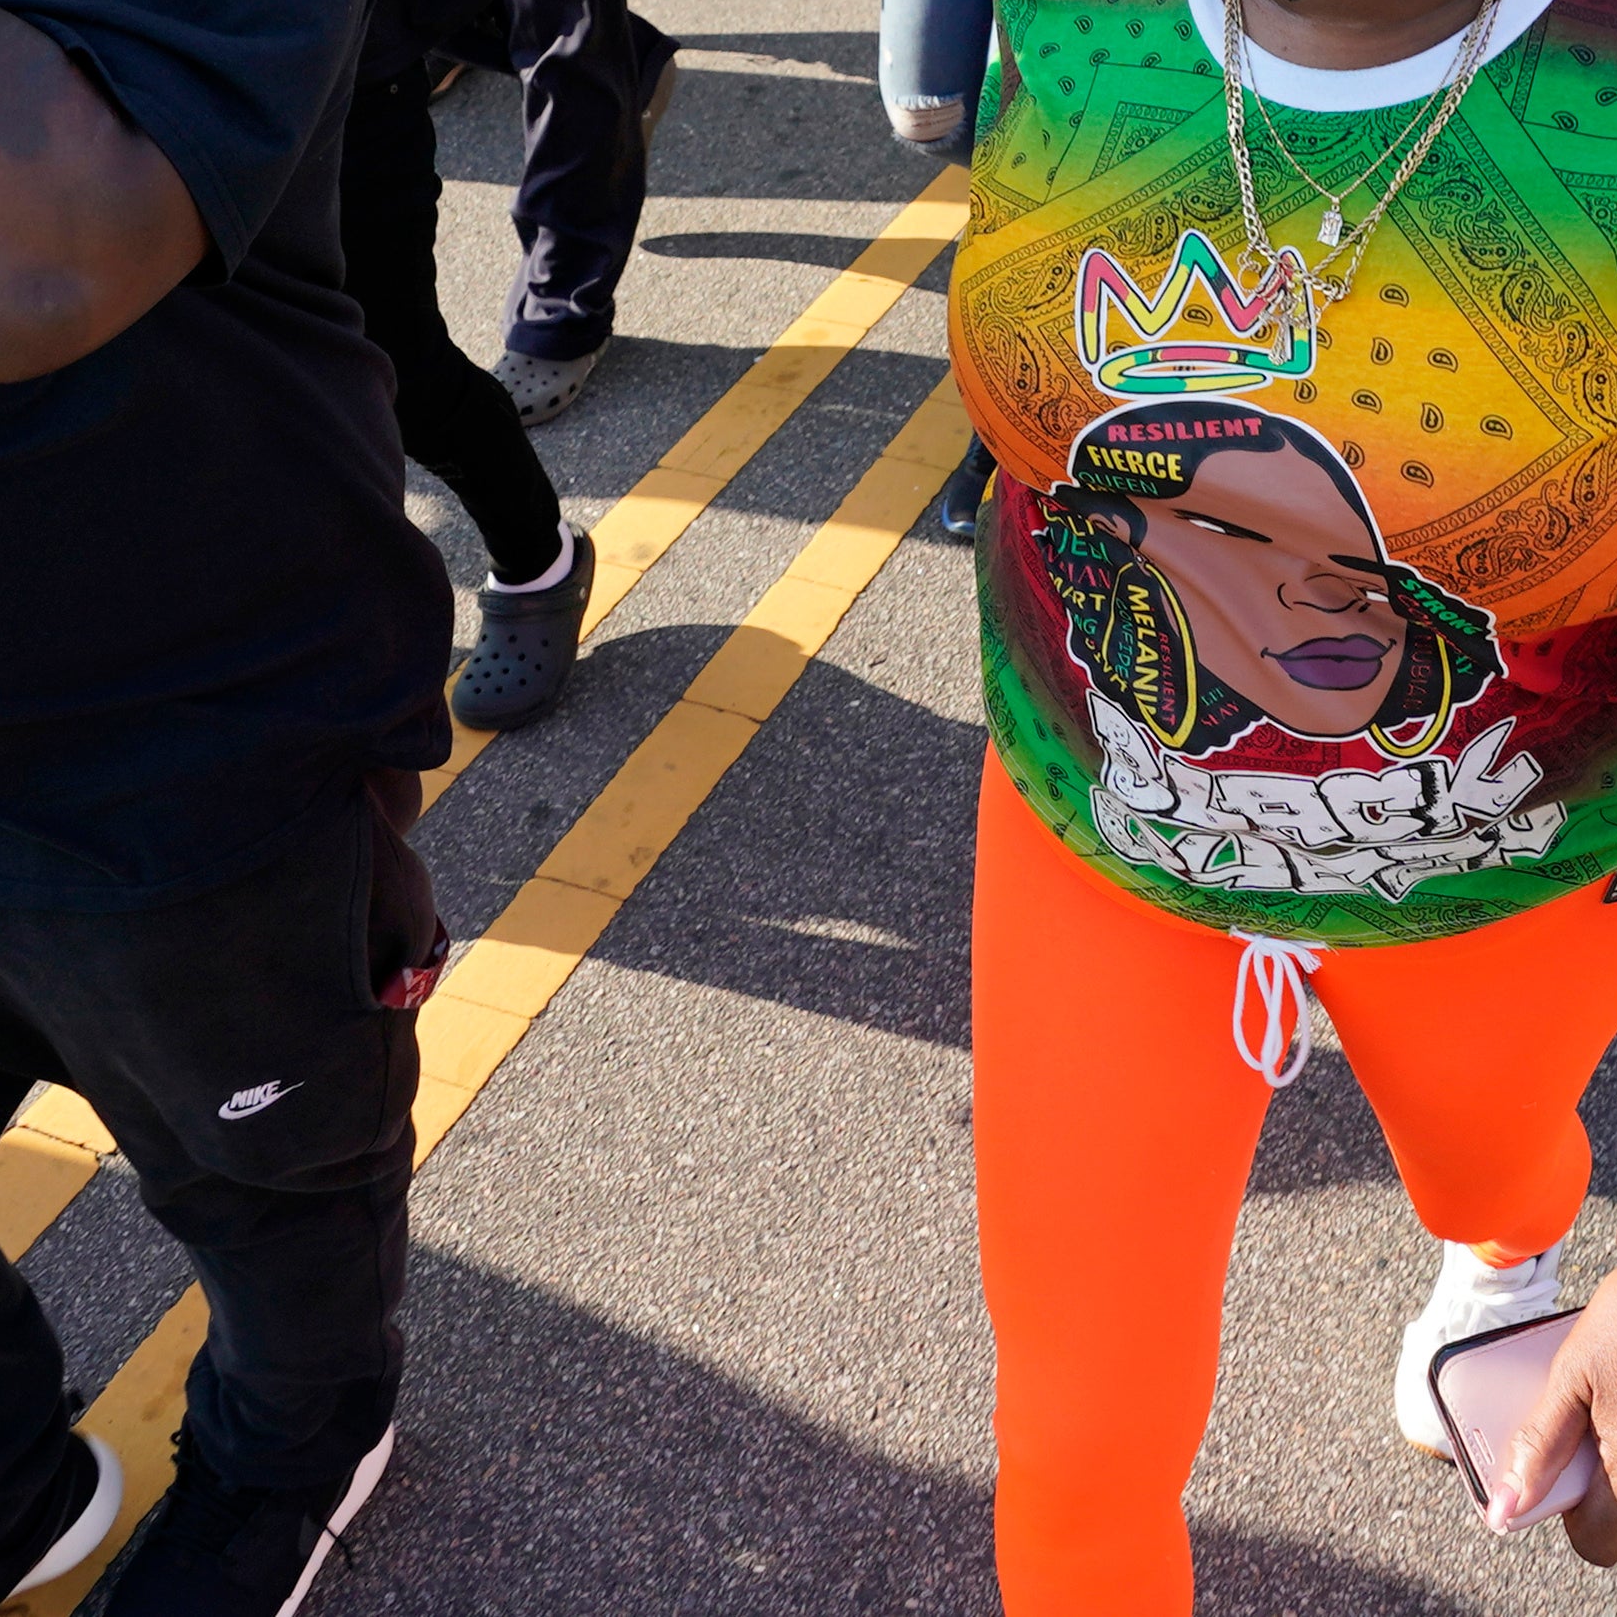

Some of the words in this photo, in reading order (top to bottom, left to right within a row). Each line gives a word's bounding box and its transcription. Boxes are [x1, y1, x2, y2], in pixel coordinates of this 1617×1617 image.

[1107, 417, 1263, 444] RESILIENT
[1086, 444, 1184, 482] FIERCE
[1077, 471, 1160, 496] QUEEN
[1399, 578, 1483, 636] STRONG
[1158, 632, 1177, 727] RESILIENT
[1086, 687, 1545, 850] BLACK
[229, 1080, 282, 1110] NIKE
